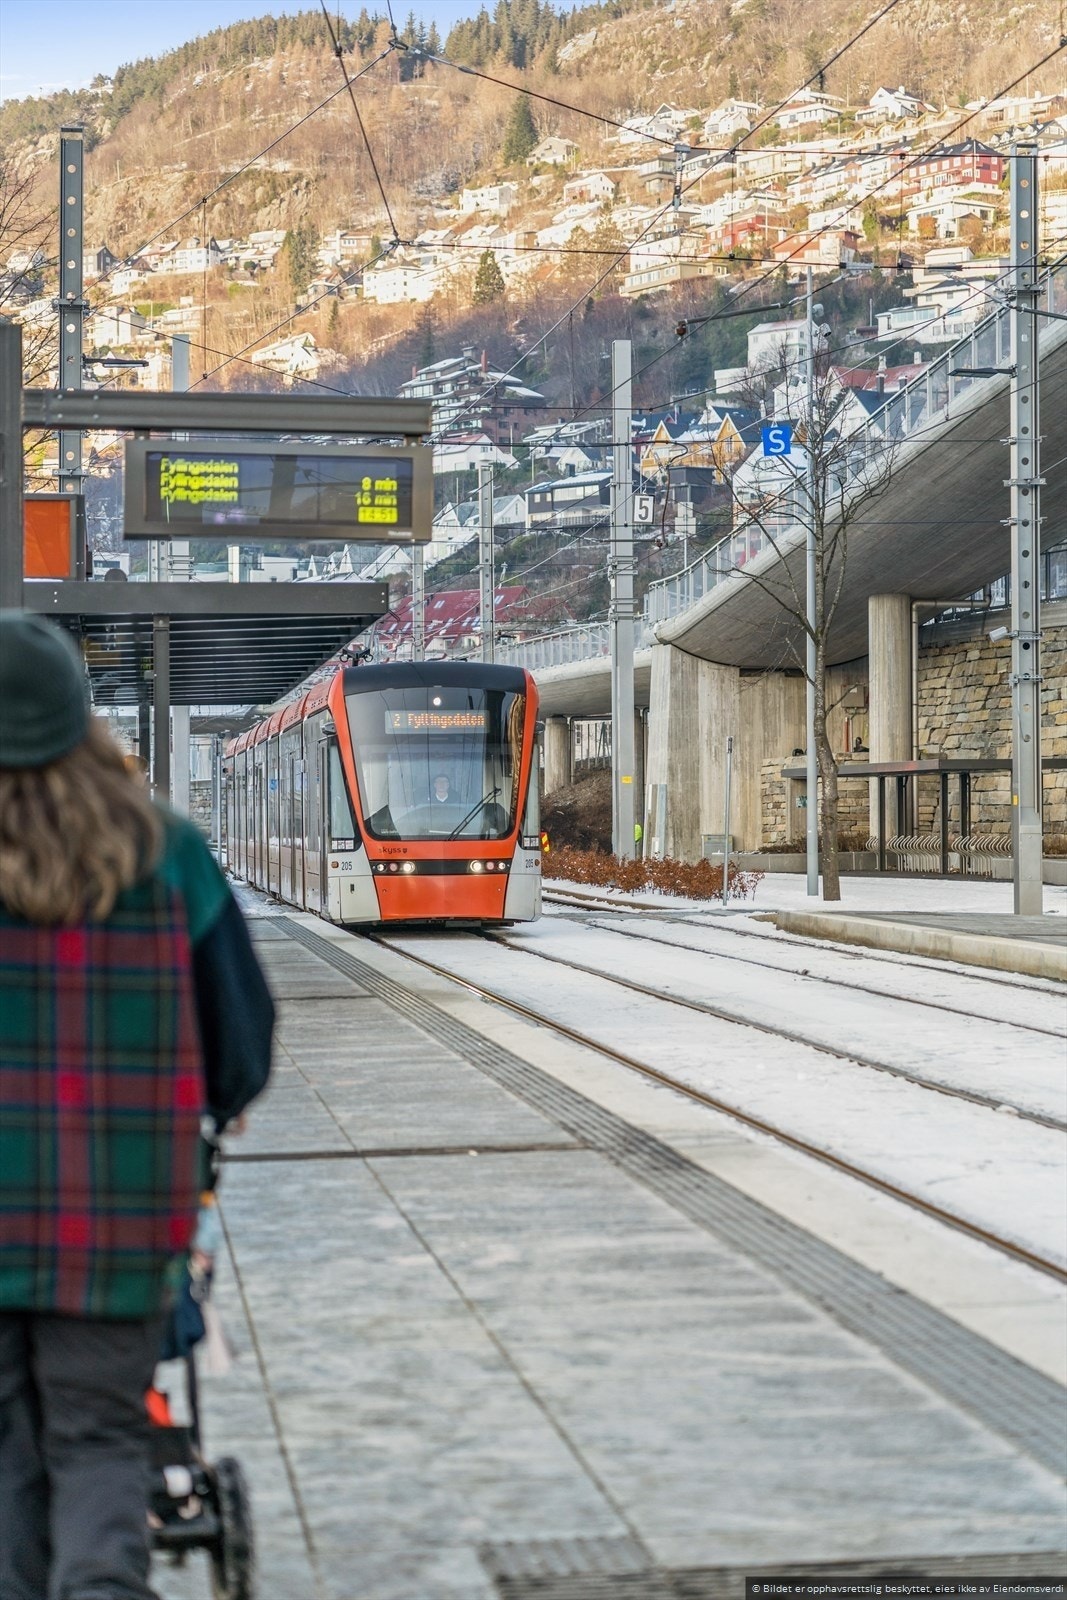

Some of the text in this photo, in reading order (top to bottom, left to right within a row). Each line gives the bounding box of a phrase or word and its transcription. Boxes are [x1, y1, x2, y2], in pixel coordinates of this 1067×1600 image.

[768, 429, 786, 455] S
[361, 476, 371, 491] 8
[375, 477, 398, 491] min
[355, 491, 371, 506] 16
[374, 492, 398, 506] min
[637, 497, 649, 521] 5
[394, 713, 485, 729] 2 Fyllingsdalen
[341, 861, 353, 871] 205
[525, 858, 534, 869] 205
